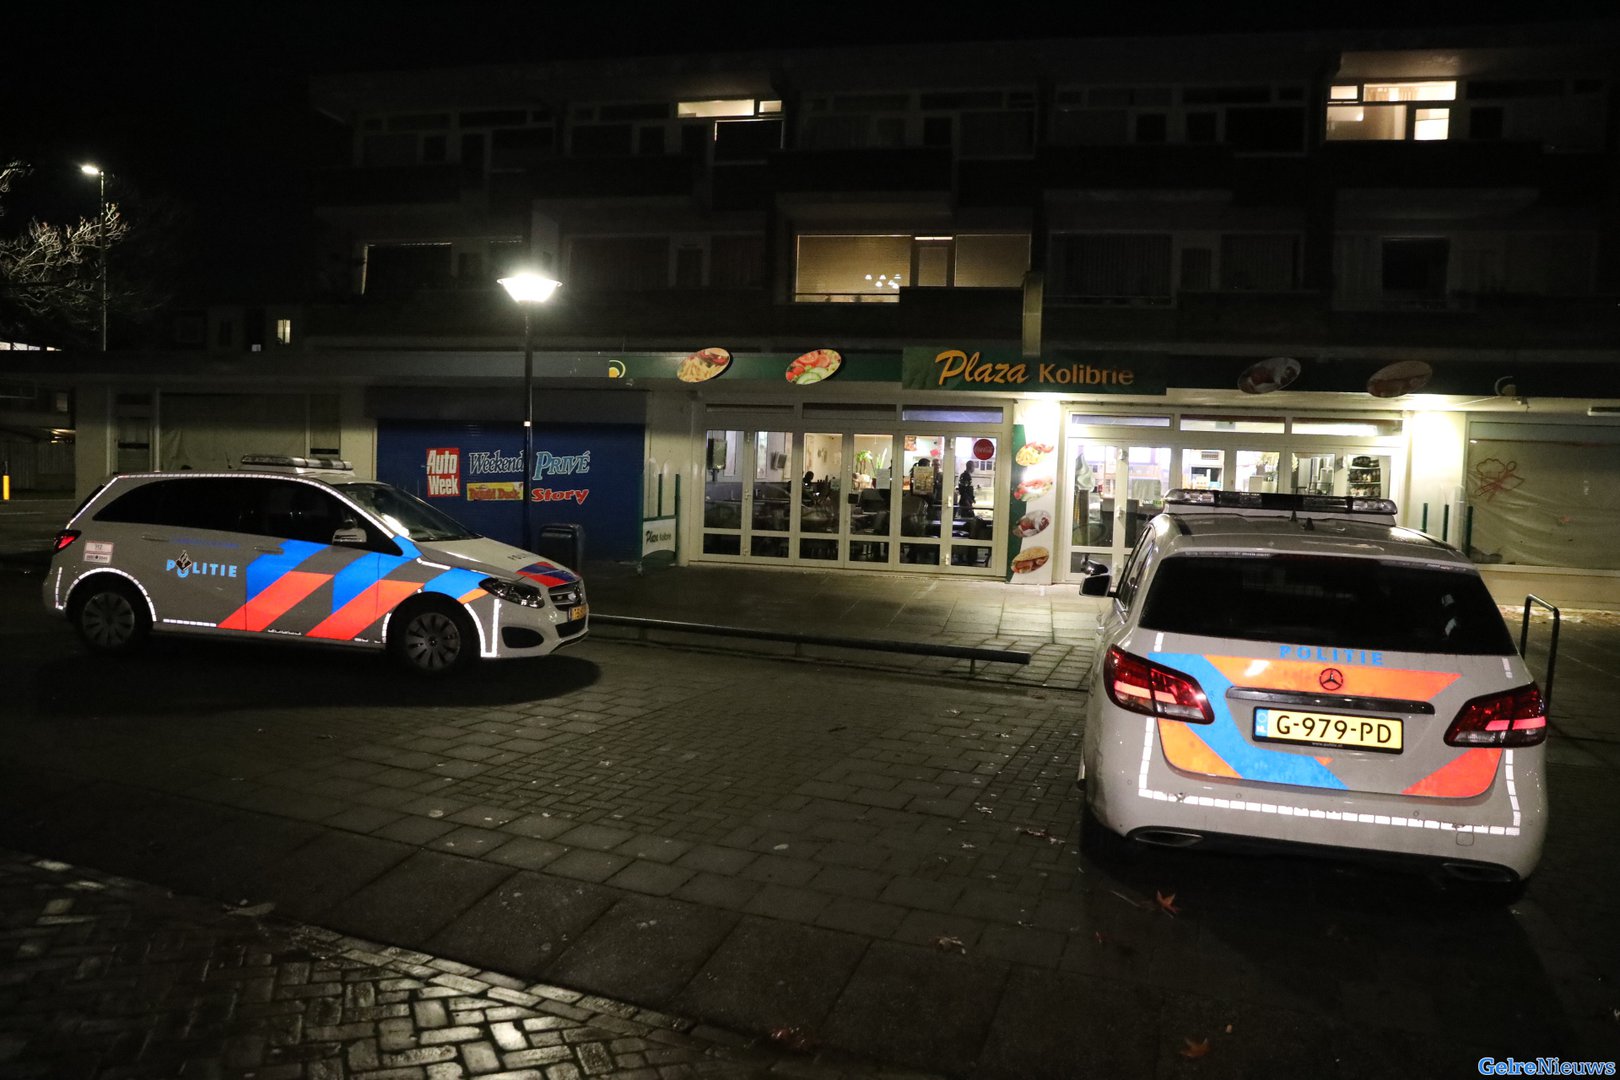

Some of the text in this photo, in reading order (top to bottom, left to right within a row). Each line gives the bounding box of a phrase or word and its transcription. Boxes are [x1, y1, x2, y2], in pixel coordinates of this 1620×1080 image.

[935, 349, 1134, 386] Plaza Kolibrie
[426, 449, 458, 475] Auto
[468, 449, 524, 475] Weekend
[428, 474, 459, 496] Week
[531, 487, 590, 506] Story
[1279, 645, 1384, 666] POLITIE
[1276, 714, 1392, 744] G-979-PD
